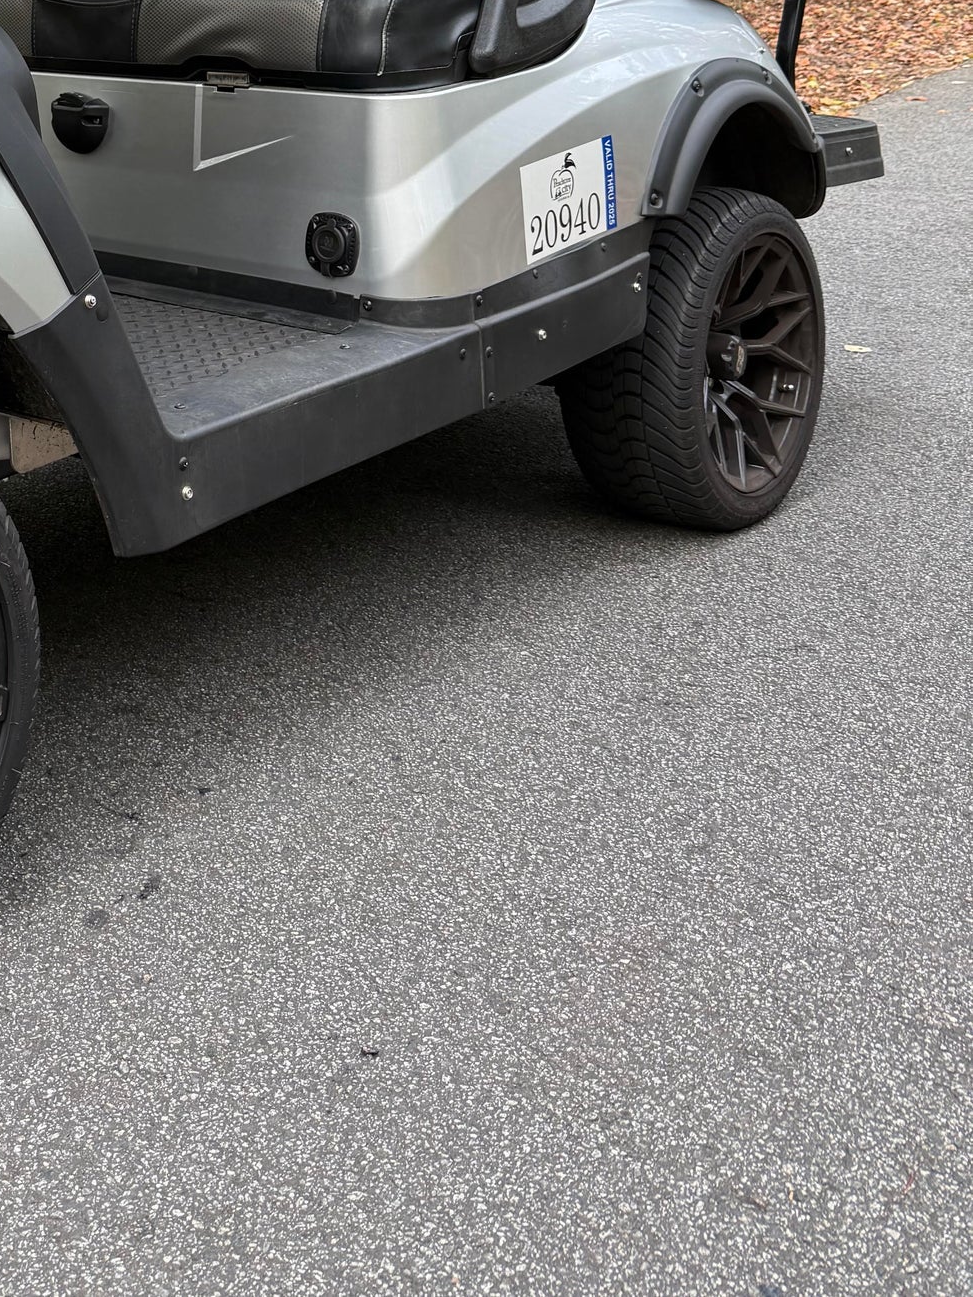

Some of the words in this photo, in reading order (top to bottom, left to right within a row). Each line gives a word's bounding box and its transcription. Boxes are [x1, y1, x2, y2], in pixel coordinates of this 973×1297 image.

[604, 139, 613, 171] VALID
[607, 172, 615, 200] THRU
[530, 192, 601, 256] 20940
